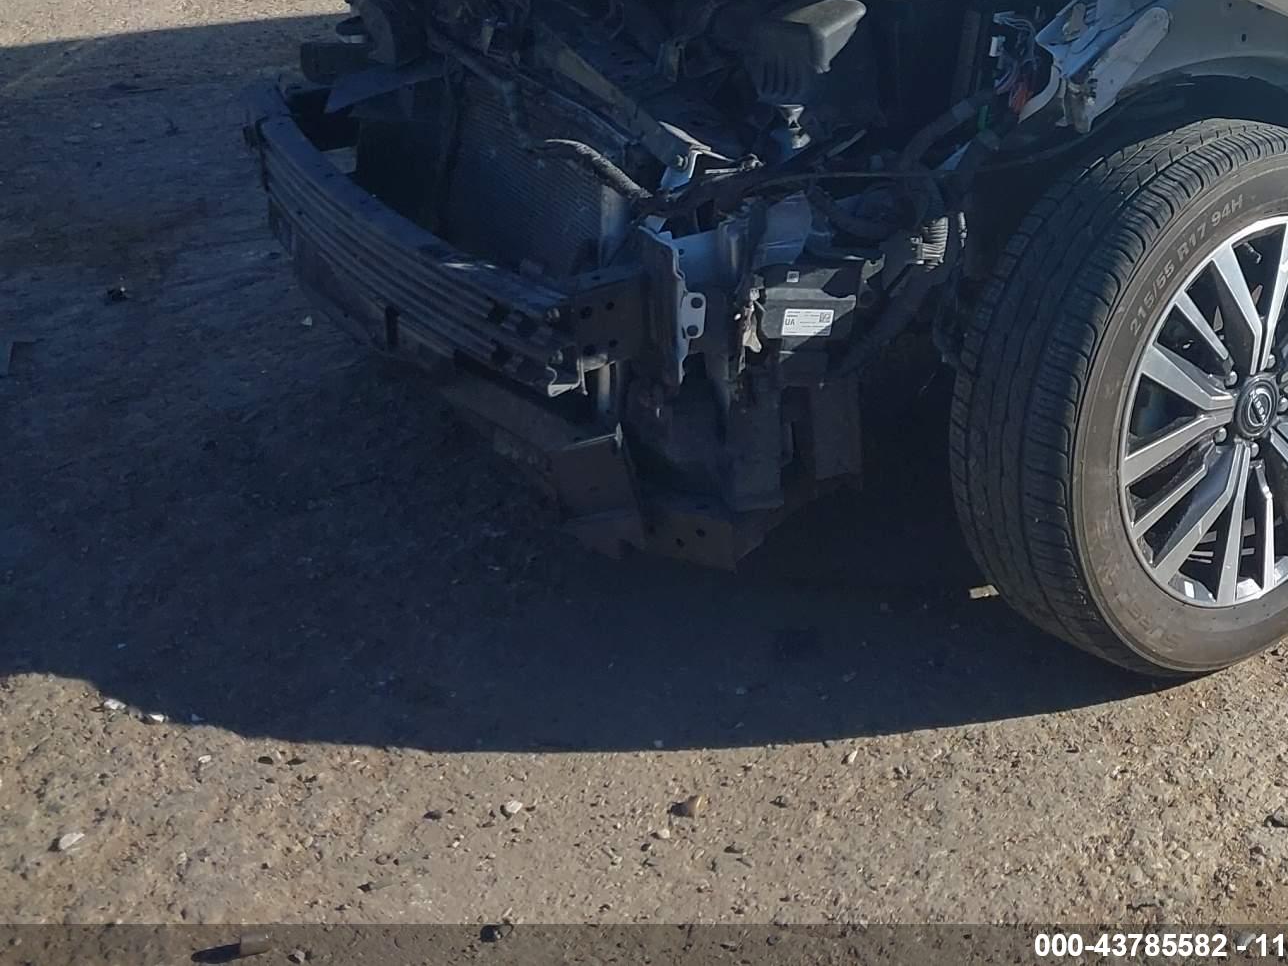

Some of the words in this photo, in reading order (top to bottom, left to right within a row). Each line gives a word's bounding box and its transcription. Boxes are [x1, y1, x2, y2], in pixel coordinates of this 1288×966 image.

[1130, 259, 1176, 337] 215/55
[1177, 222, 1208, 262] R17
[1211, 194, 1244, 227] 94H
